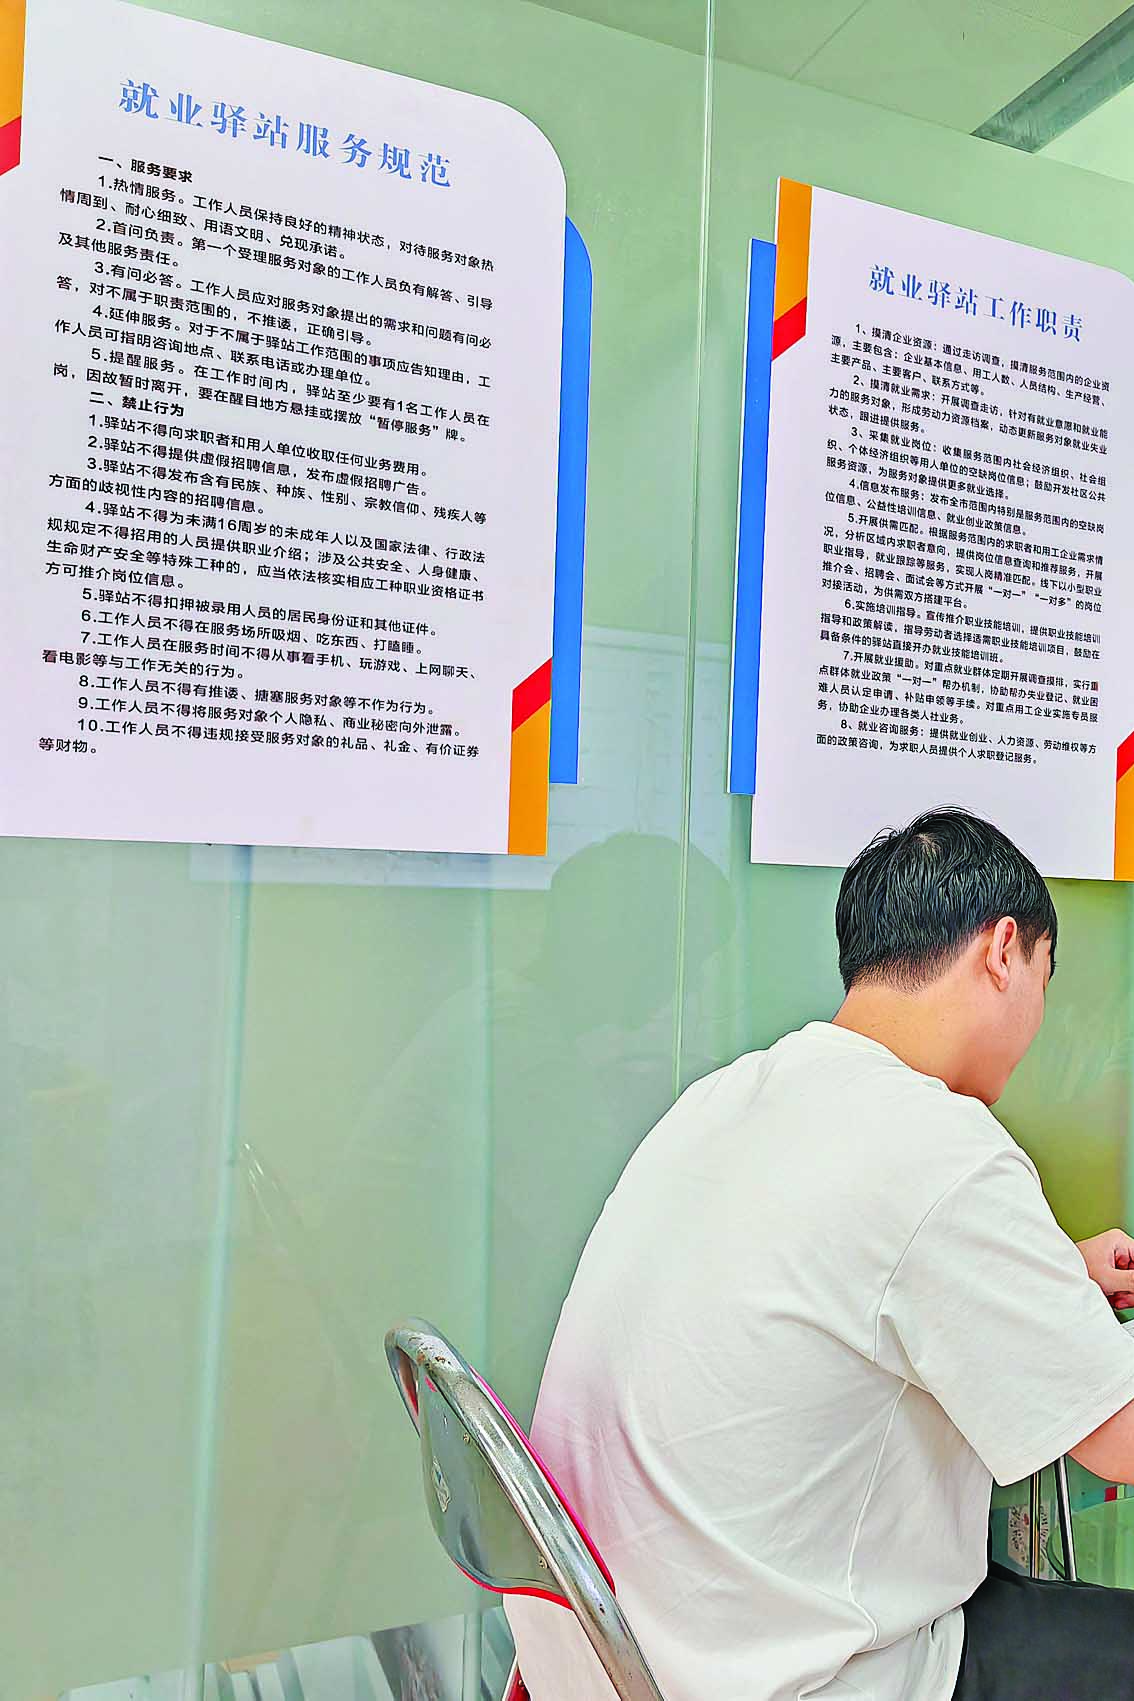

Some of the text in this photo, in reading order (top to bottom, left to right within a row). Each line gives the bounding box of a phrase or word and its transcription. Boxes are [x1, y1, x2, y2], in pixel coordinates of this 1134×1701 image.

[118, 79, 453, 188] 就业驿站服务规范
[98, 156, 193, 184] 一、服务要求
[60, 188, 347, 260] 情周到、耐心细致、用语文明、兑现承诺。
[58, 233, 180, 267] 及其他服务责任。
[869, 264, 1083, 342] 就业驿站工作职责
[89, 393, 185, 417] 二、禁止行为
[49, 473, 264, 514] 方面的歧视性内容的招聘信息。
[45, 562, 184, 589] 方可推介岗位信息。
[41, 649, 246, 679] 看电影等与工作无关的行为。
[39, 737, 98, 754] 等财物。
